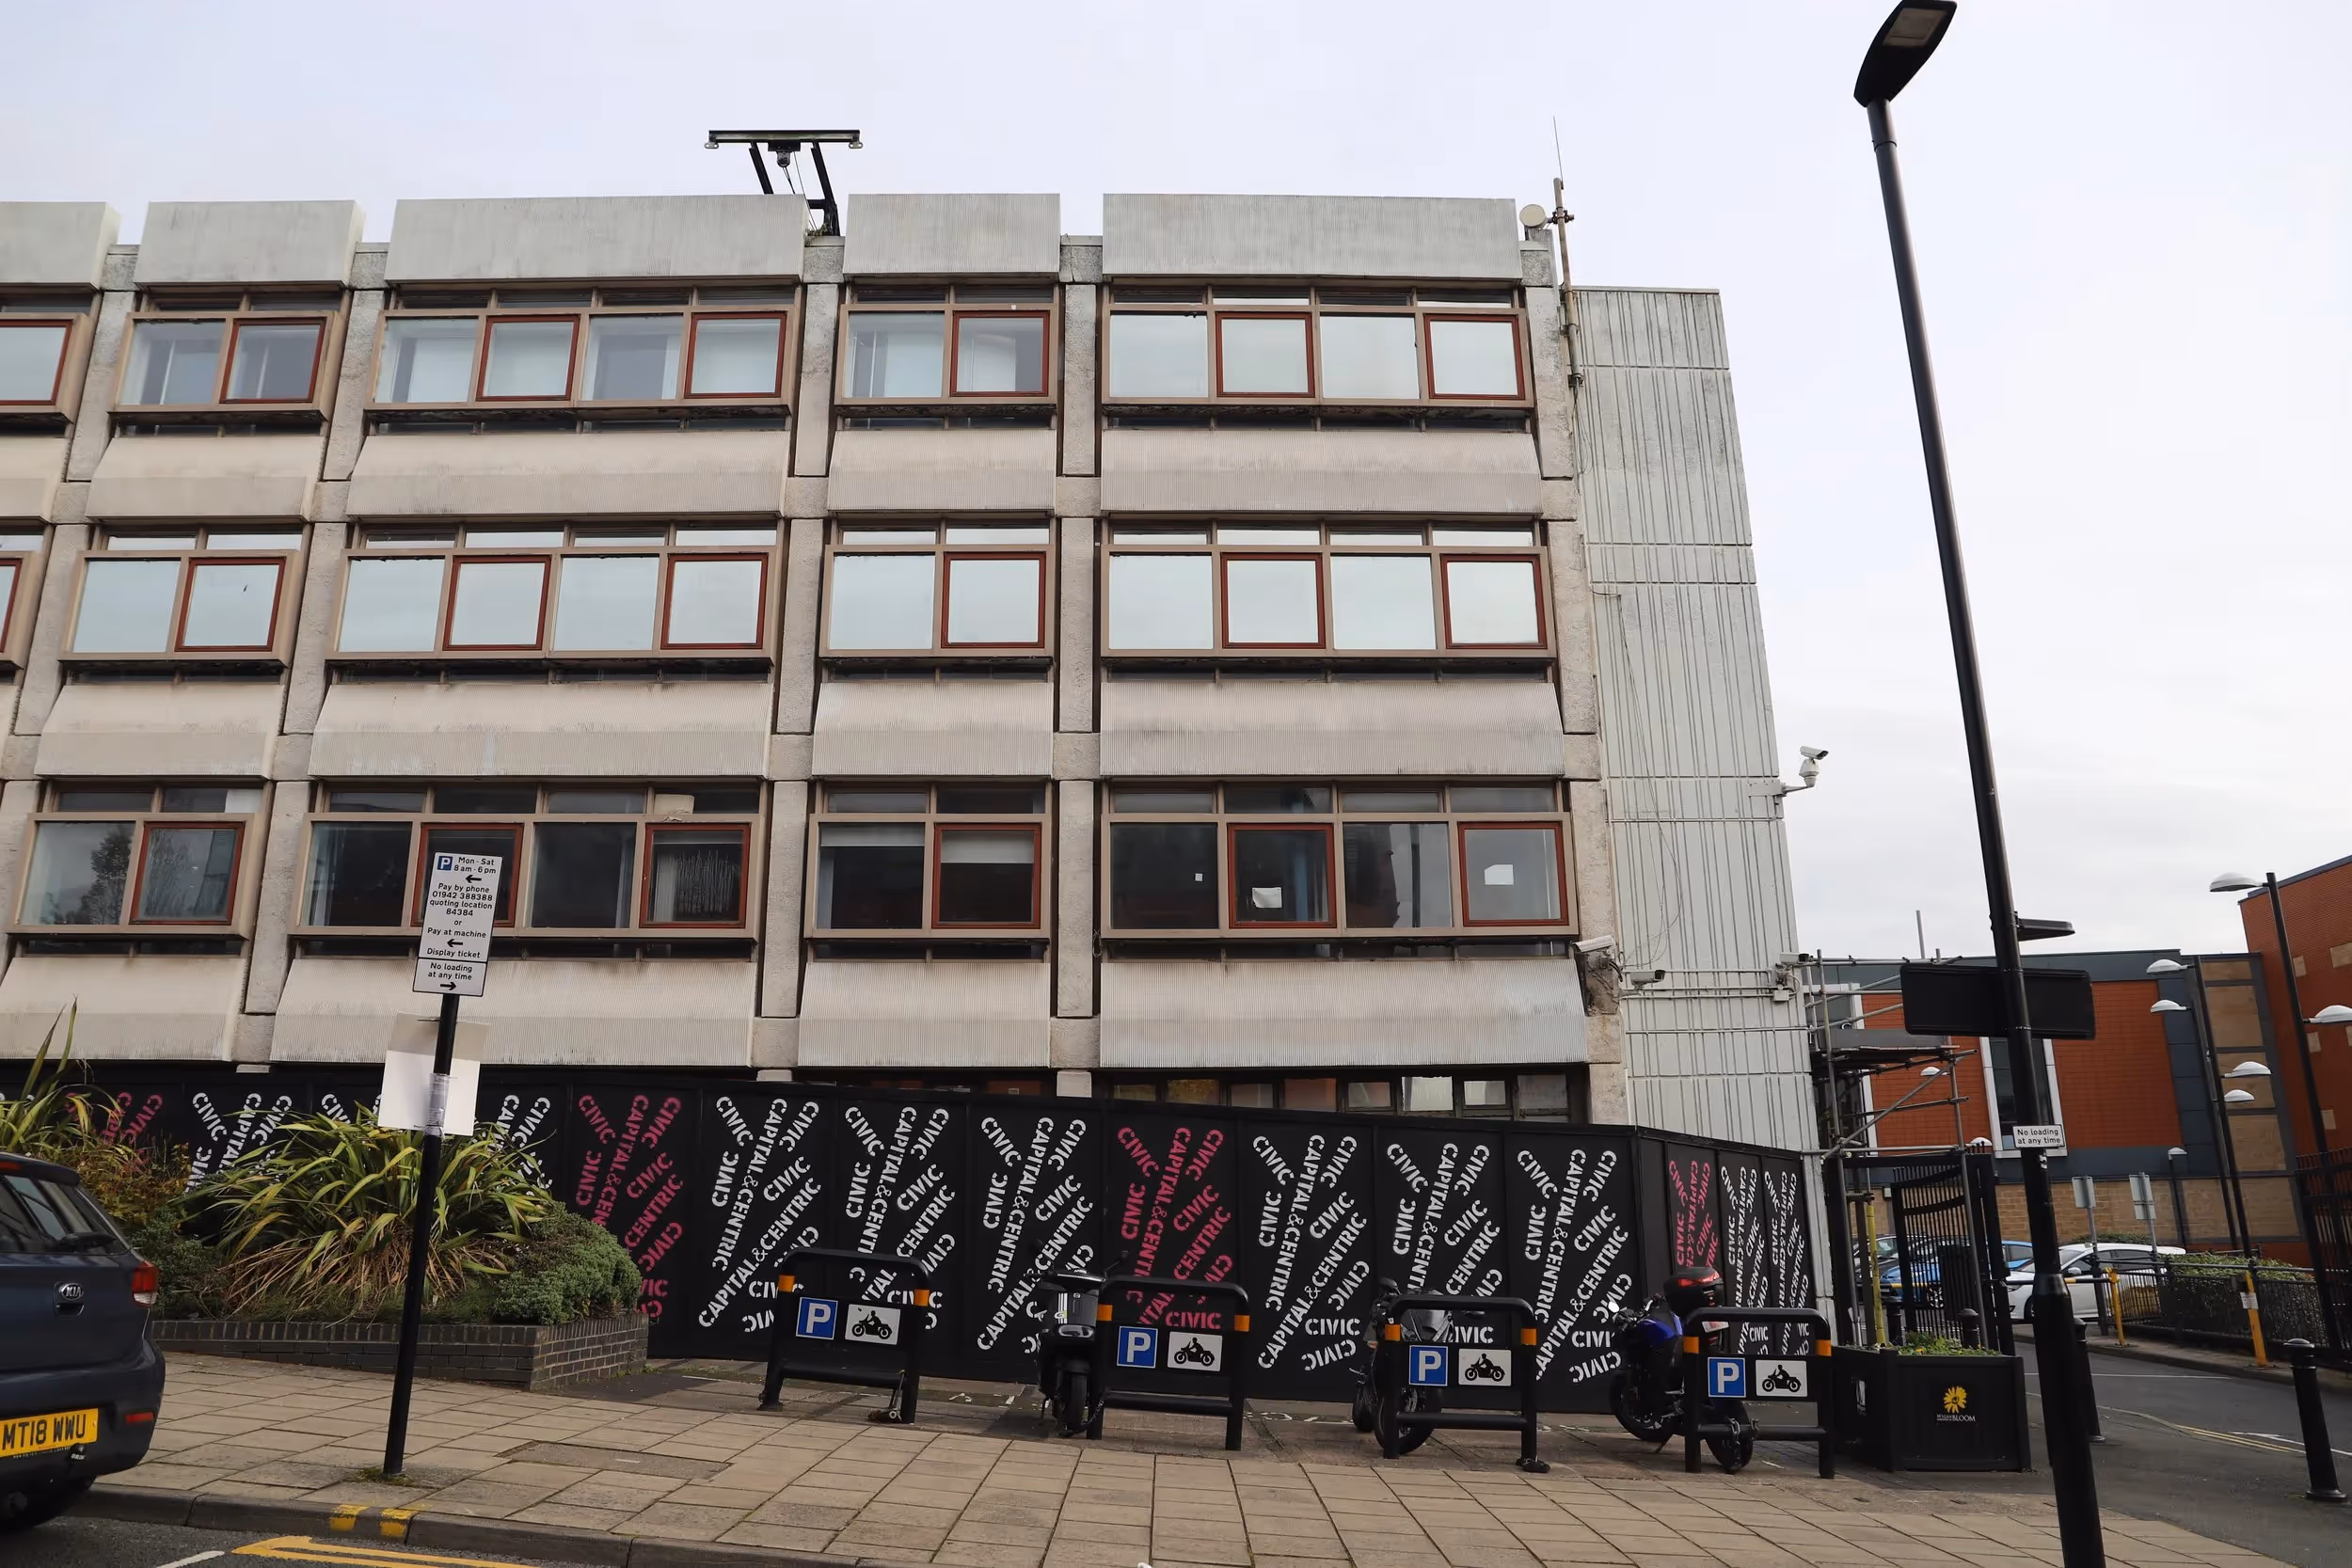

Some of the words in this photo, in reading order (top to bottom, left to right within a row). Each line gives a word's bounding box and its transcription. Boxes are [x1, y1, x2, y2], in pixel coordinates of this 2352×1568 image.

[439, 857, 452, 870] P
[481, 858, 495, 866] Sat
[430, 899, 459, 909] quoting
[461, 901, 493, 910] location
[432, 891, 457, 899] 01942
[460, 893, 493, 901] 388388
[438, 883, 453, 892] Pay
[466, 885, 490, 894] phone
[427, 927, 441, 936] Pay
[454, 930, 486, 939] machine
[446, 909, 473, 917] 84384
[427, 948, 456, 958] Display
[458, 949, 481, 958] ticket
[430, 962, 442, 971] No
[444, 963, 473, 973] loading
[438, 973, 453, 981] any
[455, 973, 472, 981] time
[192, 1092, 227, 1141] CIVIC
[511, 1097, 550, 1148] CIVIC
[579, 1094, 617, 1144] CIVIC
[642, 1097, 681, 1149] CIVIC
[716, 1096, 754, 1147] CIVIC
[779, 1101, 819, 1153] CIVIC
[845, 1106, 884, 1156] CIVIC
[911, 1108, 949, 1161] CIVIC
[981, 1117, 1022, 1167] CIVIC
[1047, 1119, 1086, 1171] CIVIC
[1117, 1127, 1159, 1178] CIVIC
[1184, 1130, 1223, 1181] CIVIC
[1253, 1136, 1295, 1185] CIVIC
[1320, 1136, 1357, 1188] CIVIC
[184, 1147, 212, 1193] IVIC
[576, 1150, 601, 1205] CIVIC
[627, 1152, 674, 1198] CIVIC
[711, 1150, 739, 1207] CIVIC
[763, 1156, 811, 1201] CIVIC
[846, 1162, 871, 1218] CIVIC
[897, 1164, 944, 1211] CIVIC
[1387, 1143, 1428, 1193] CIVIC
[1454, 1145, 1489, 1196] CIVIC
[1517, 1149, 1557, 1199] CIVIC
[1582, 1150, 1617, 1202] CIVIC
[1668, 1160, 1688, 1207] CIVIC
[1697, 1163, 1710, 1211] CIVIC
[1721, 1165, 1739, 1211] CIVIC
[1746, 1168, 1757, 1213] CIVIC
[1764, 1170, 1781, 1213] CIVIC
[982, 1172, 1008, 1228] CIVIC
[1035, 1175, 1081, 1221] CIVIC
[1120, 1182, 1146, 1240] CIVIC
[1173, 1184, 1219, 1232] CIVIC
[1310, 1191, 1355, 1238] CIVIC
[1788, 1173, 1797, 1216] CIVIC
[1258, 1191, 1281, 1246] CIVIC
[1392, 1197, 1416, 1255] CIVIC
[1444, 1199, 1487, 1246] CIVIC
[1524, 1204, 1546, 1260] CIVIC
[1574, 1205, 1616, 1252] CIVIC
[1677, 1212, 1685, 1266] CIVIC
[1696, 1213, 1713, 1257] CIVIC
[1745, 1216, 1760, 1258] CIVIC
[1787, 1218, 1800, 1259] CIVIC
[638, 1222, 683, 1272] CIVIC
[65, 1286, 83, 1298] KIA
[1327, 1260, 1370, 1311] CIVIC
[805, 1302, 831, 1334] P
[1165, 1311, 1221, 1329] CIVIC
[1305, 1318, 1360, 1336] CIVIC
[1454, 1325, 1494, 1343] IVIC
[1572, 1330, 1615, 1348] CIVI
[1749, 1325, 1769, 1343] CIVIC
[1126, 1332, 1152, 1363] P
[1301, 1339, 1356, 1371] CIVIC
[1419, 1350, 1441, 1382] P
[1569, 1351, 1621, 1383] CIVIC
[1717, 1361, 1740, 1393] P
[2, 1418, 47, 1450] MT18
[53, 1414, 87, 1442] WWU
